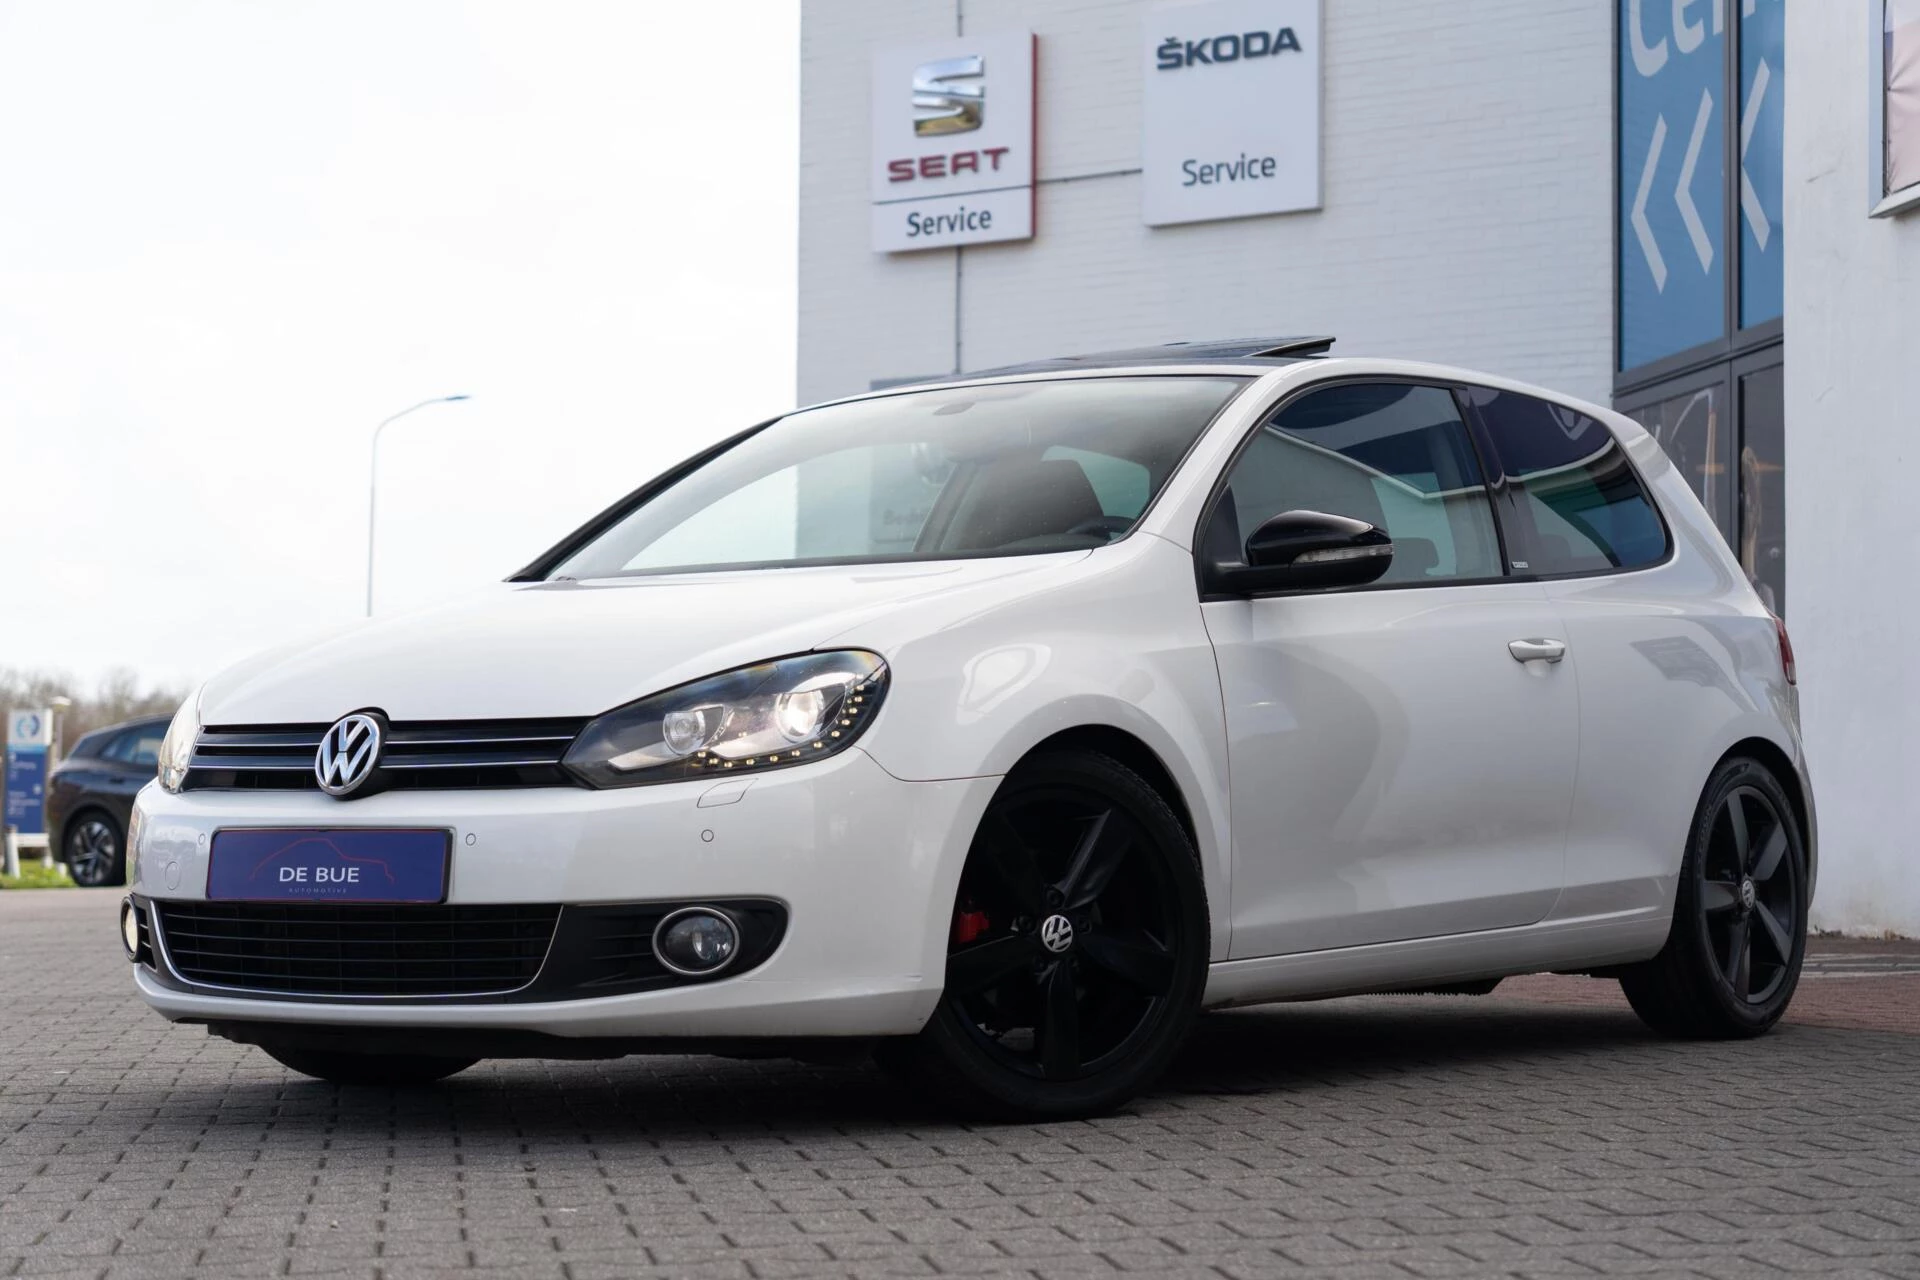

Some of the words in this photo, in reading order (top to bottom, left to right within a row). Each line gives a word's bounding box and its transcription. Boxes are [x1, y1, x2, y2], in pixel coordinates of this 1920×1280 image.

[1156, 26, 1303, 71] ŠKODA
[887, 146, 1010, 183] SEAT
[1182, 152, 1277, 188] Service
[906, 206, 993, 238] Service
[279, 866, 308, 882] DE
[315, 866, 360, 883] BUE
